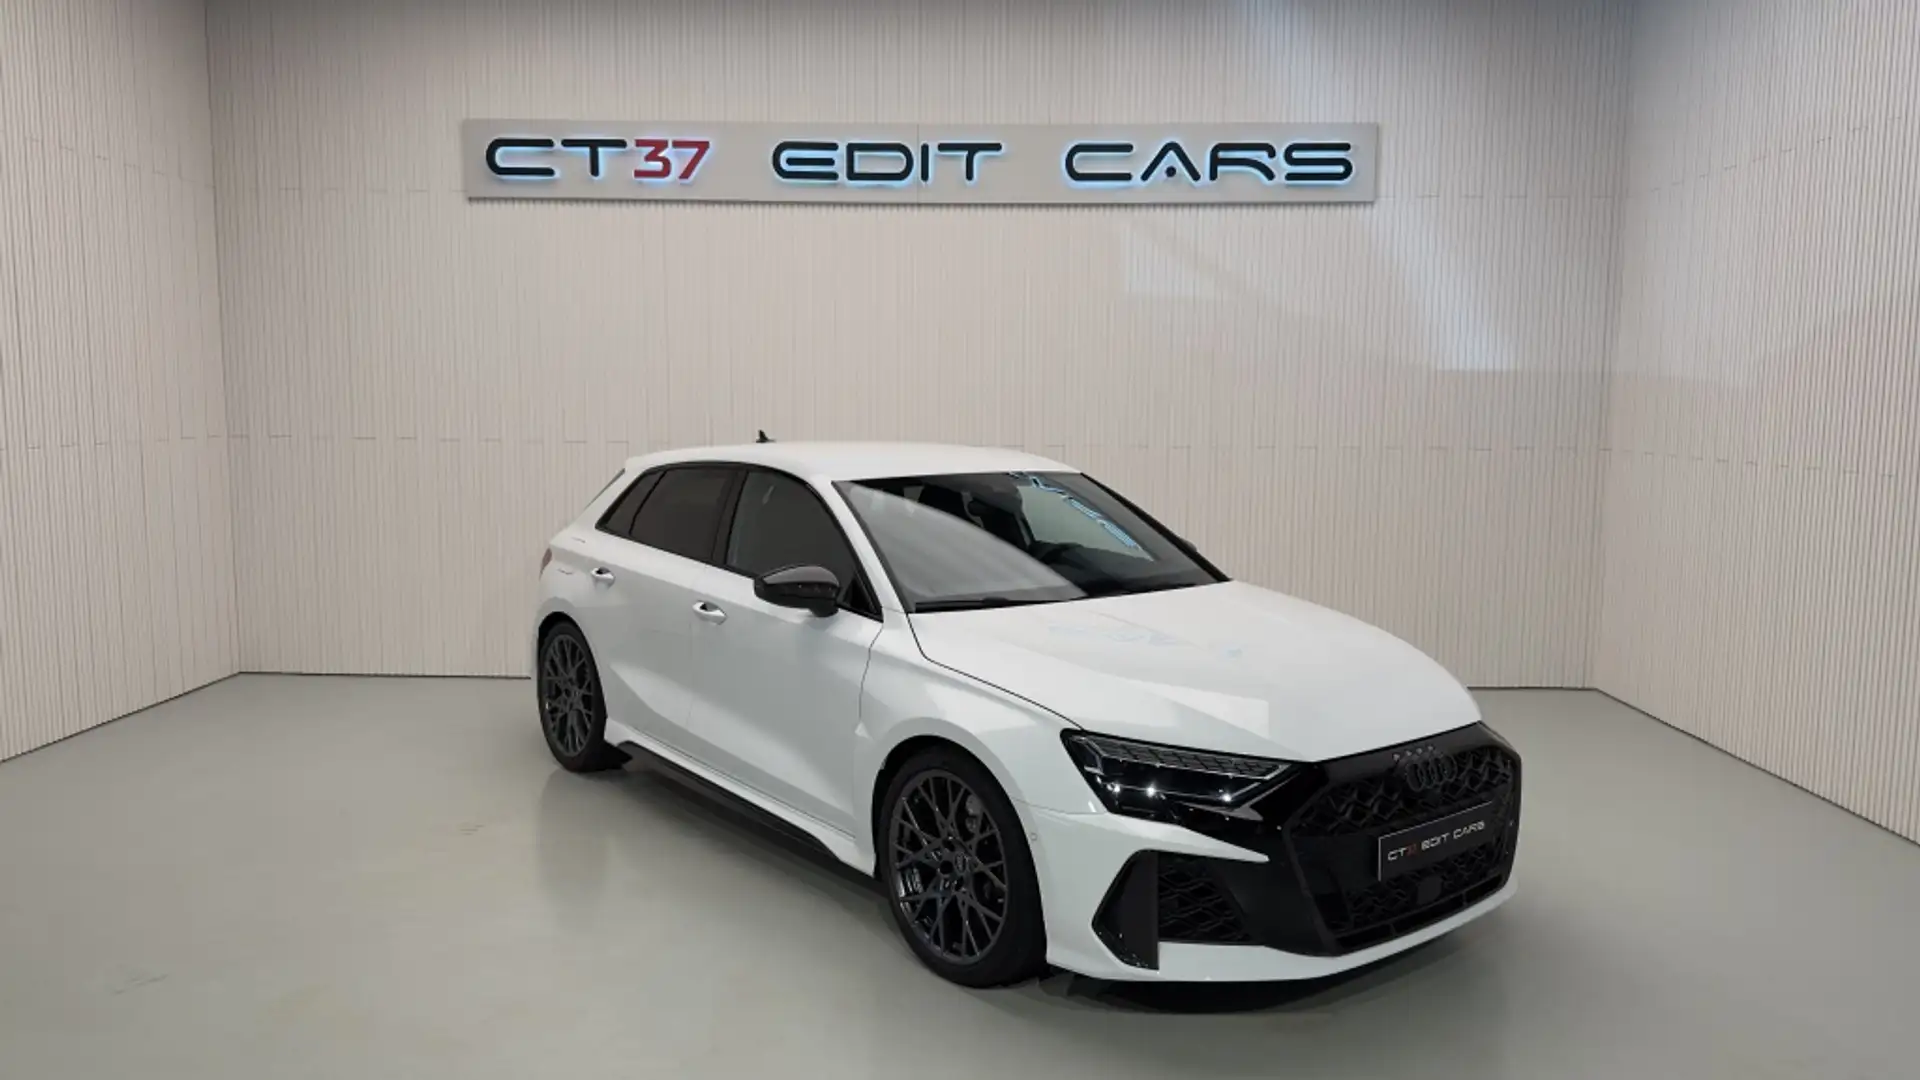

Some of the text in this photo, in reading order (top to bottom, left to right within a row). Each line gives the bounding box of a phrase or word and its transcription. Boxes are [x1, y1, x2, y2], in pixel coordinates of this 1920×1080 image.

[485, 138, 1353, 182] CT37 EDIT CARS
